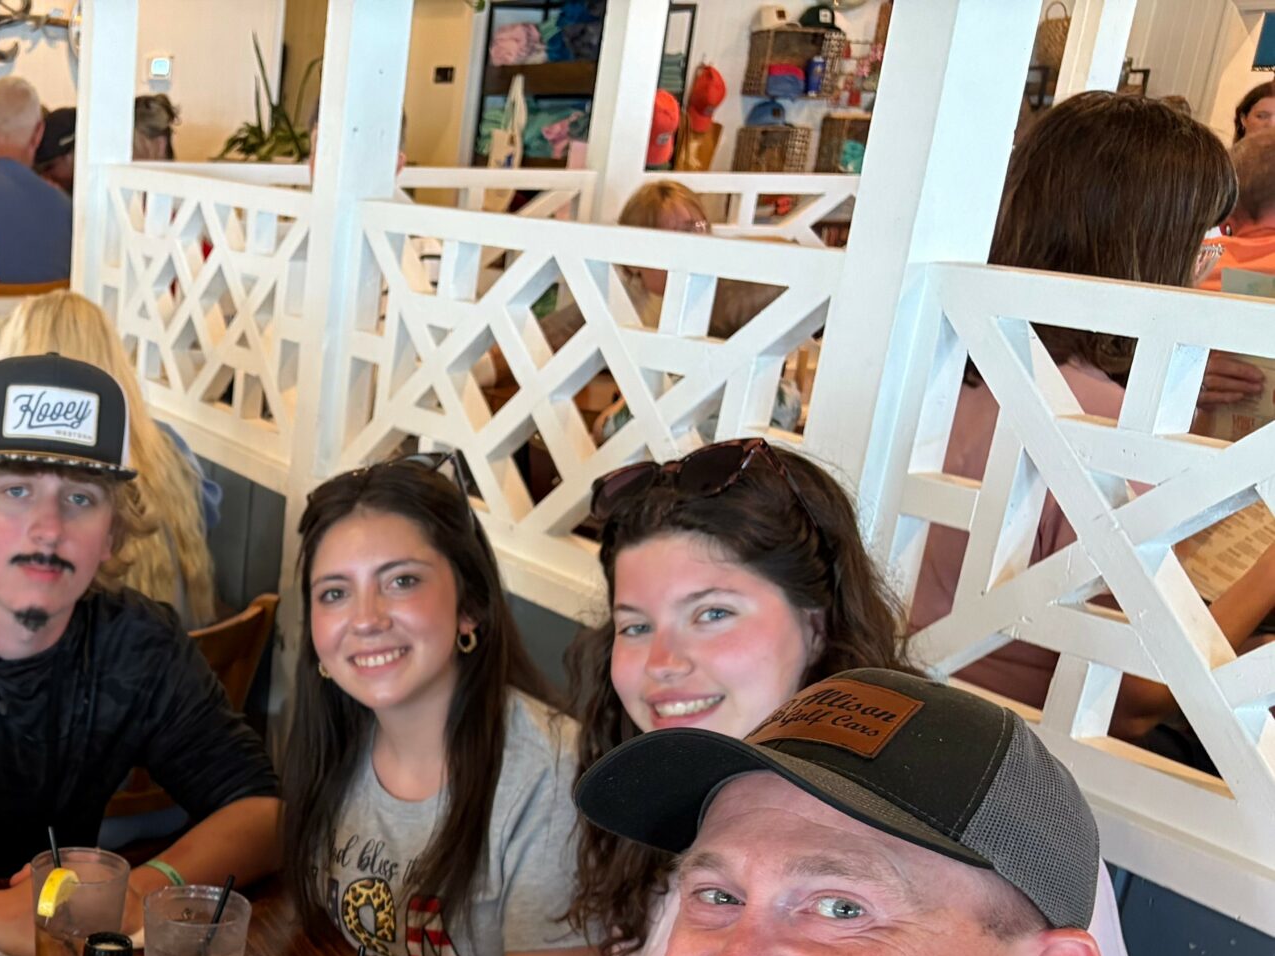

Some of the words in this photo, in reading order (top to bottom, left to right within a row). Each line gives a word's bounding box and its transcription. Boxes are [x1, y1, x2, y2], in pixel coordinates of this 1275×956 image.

[12, 391, 92, 430] Hooey
[779, 708, 833, 728] Golf
[830, 714, 880, 737] Cars
[801, 688, 897, 723] Allison
